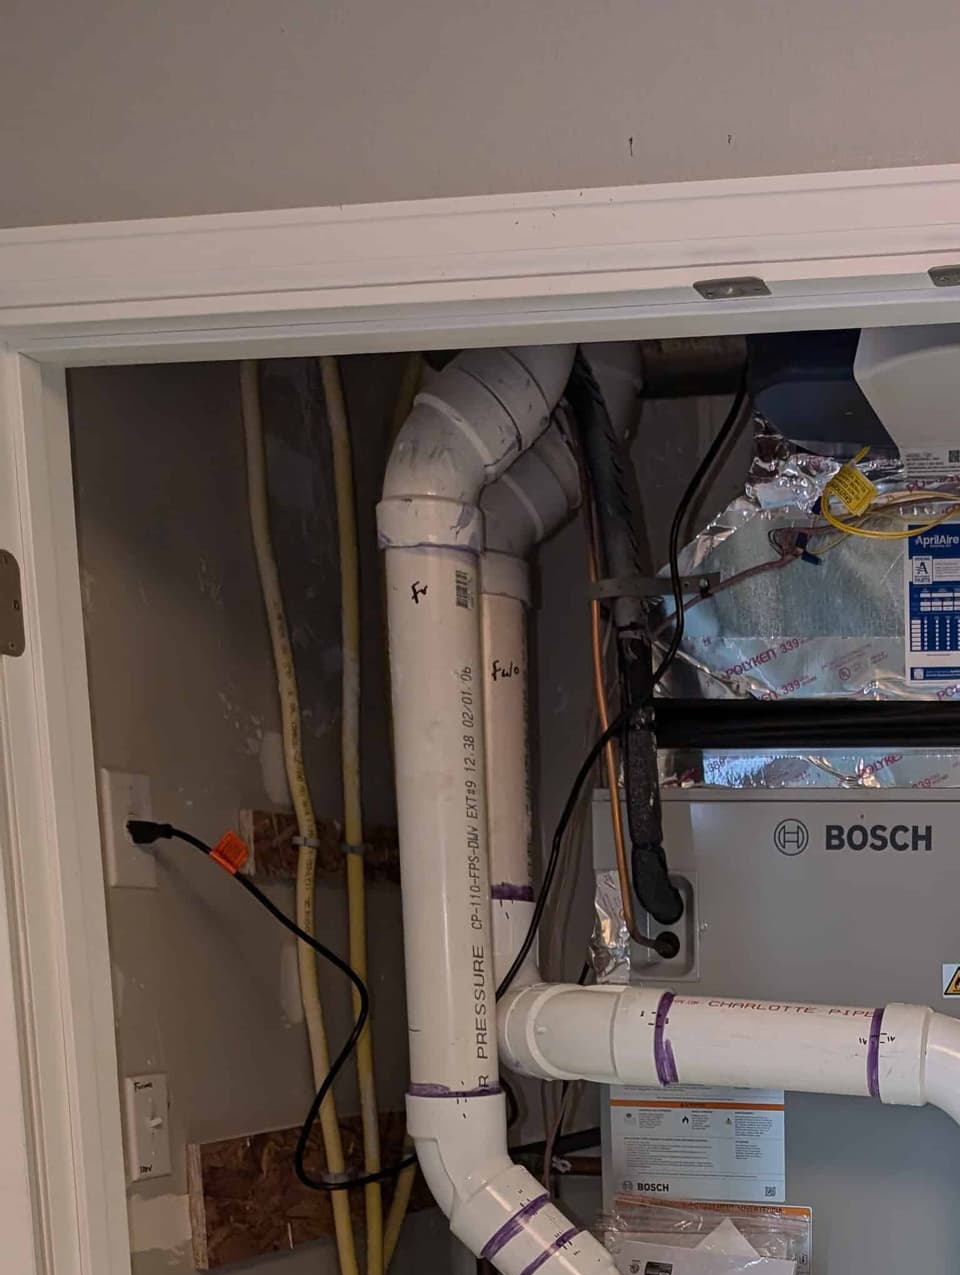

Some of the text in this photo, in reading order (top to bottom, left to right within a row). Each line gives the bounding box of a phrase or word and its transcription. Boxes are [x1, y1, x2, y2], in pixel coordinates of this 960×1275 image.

[915, 534, 960, 548] AprilAire
[779, 637, 800, 654] 339
[825, 824, 932, 851] BOSCH
[472, 944, 489, 1060] PRESSURE
[707, 1000, 818, 1014] CHARLOTTE
[637, 1182, 669, 1192] BOSCH
